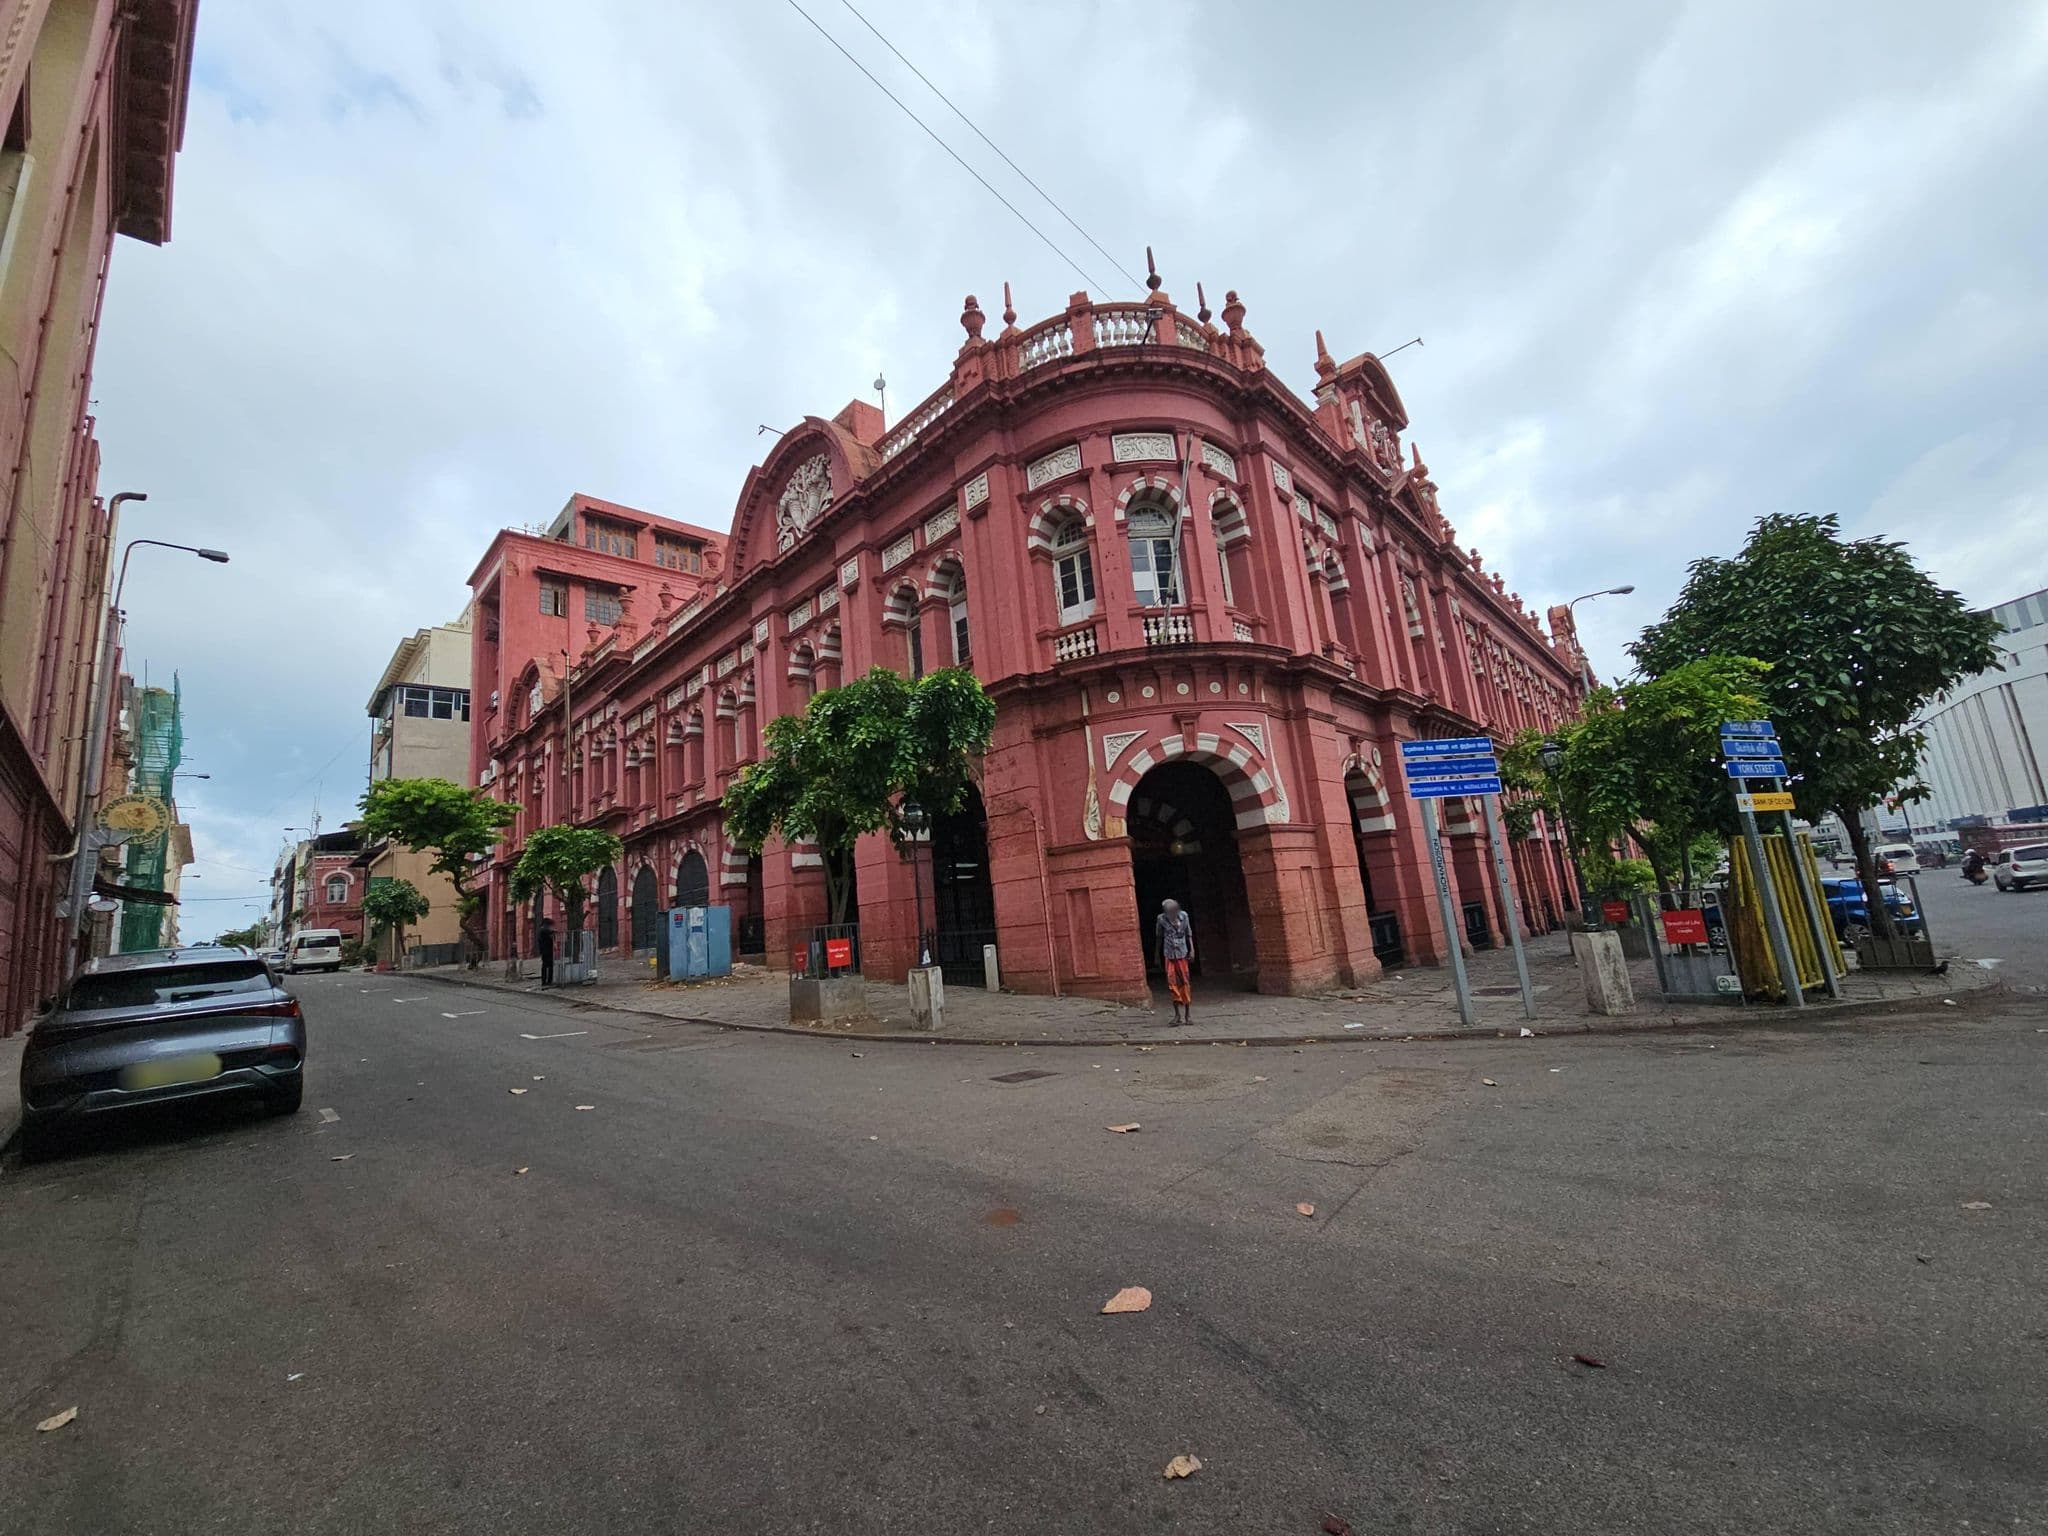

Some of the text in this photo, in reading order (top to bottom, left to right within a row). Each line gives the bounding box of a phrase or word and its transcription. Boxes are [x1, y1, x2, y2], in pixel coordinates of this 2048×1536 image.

[1738, 764, 1776, 773] YORK STREET
[1774, 797, 1793, 805] CEYLON
[100, 796, 145, 817] SPORTING
